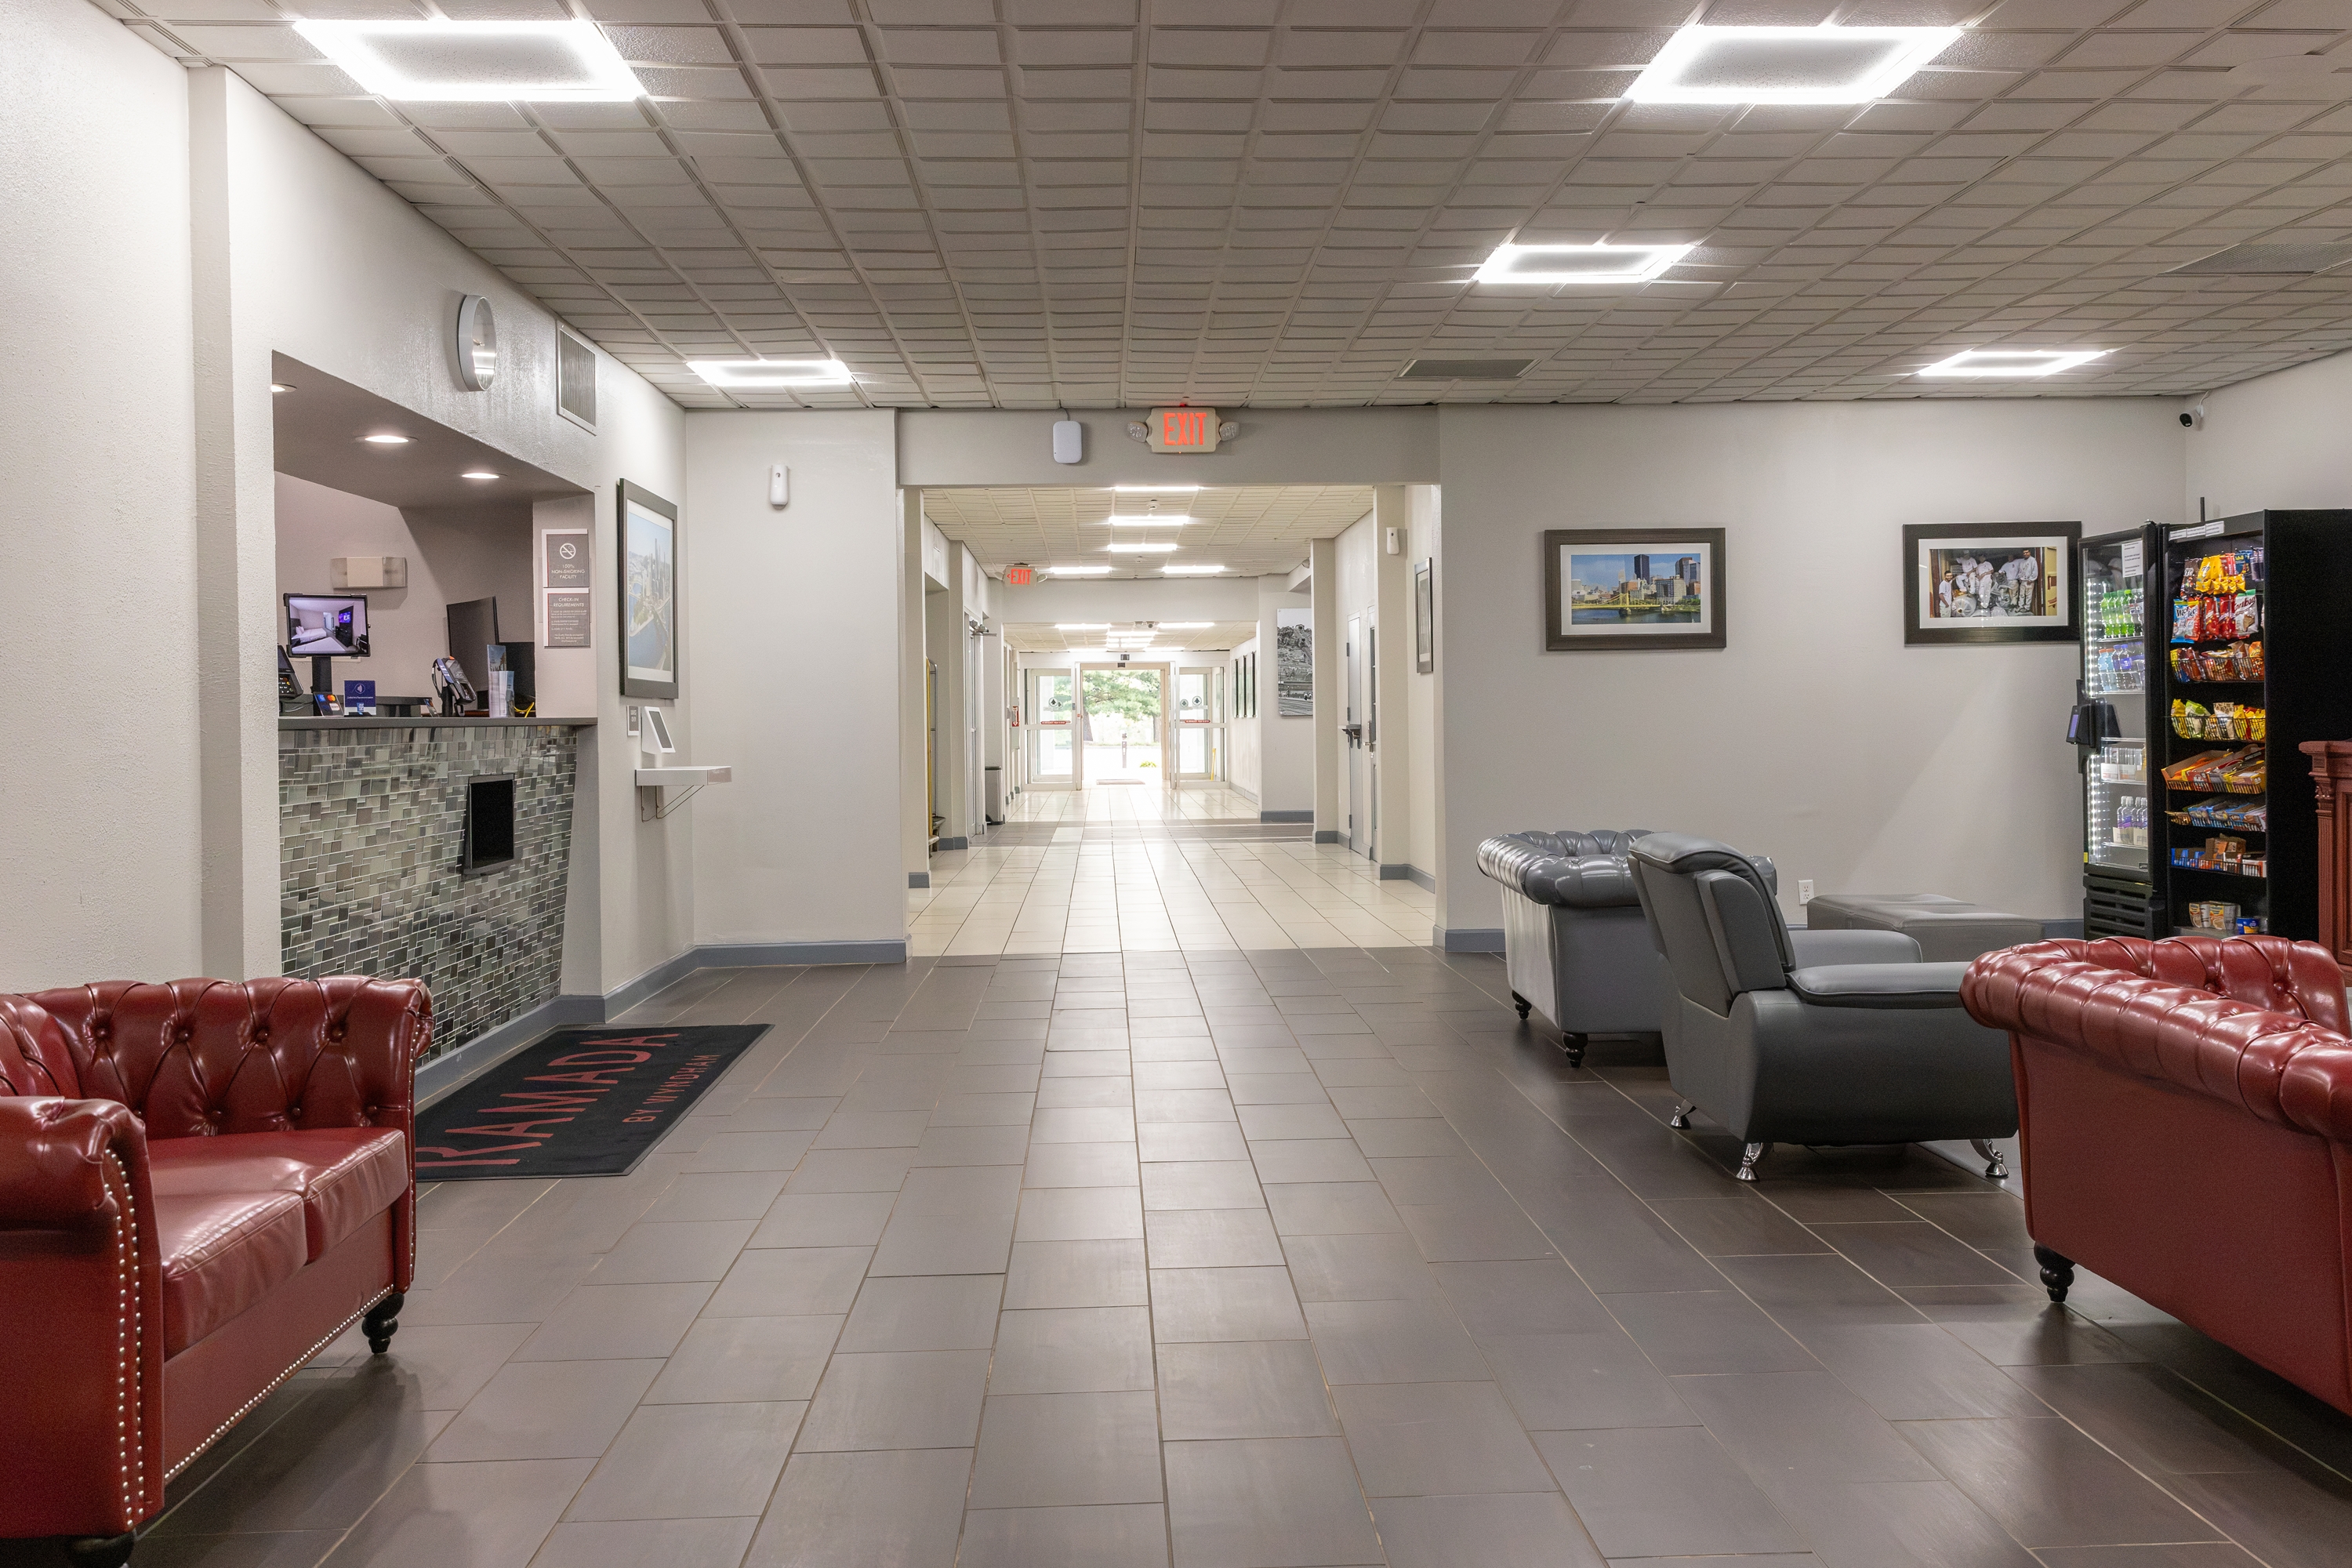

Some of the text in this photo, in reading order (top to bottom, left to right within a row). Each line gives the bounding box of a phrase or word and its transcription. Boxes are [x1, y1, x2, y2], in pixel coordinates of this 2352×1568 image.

[1163, 412, 1207, 446] EXIT
[1011, 568, 1032, 586] EXIT
[622, 1054, 722, 1123] BY WYNDHAM
